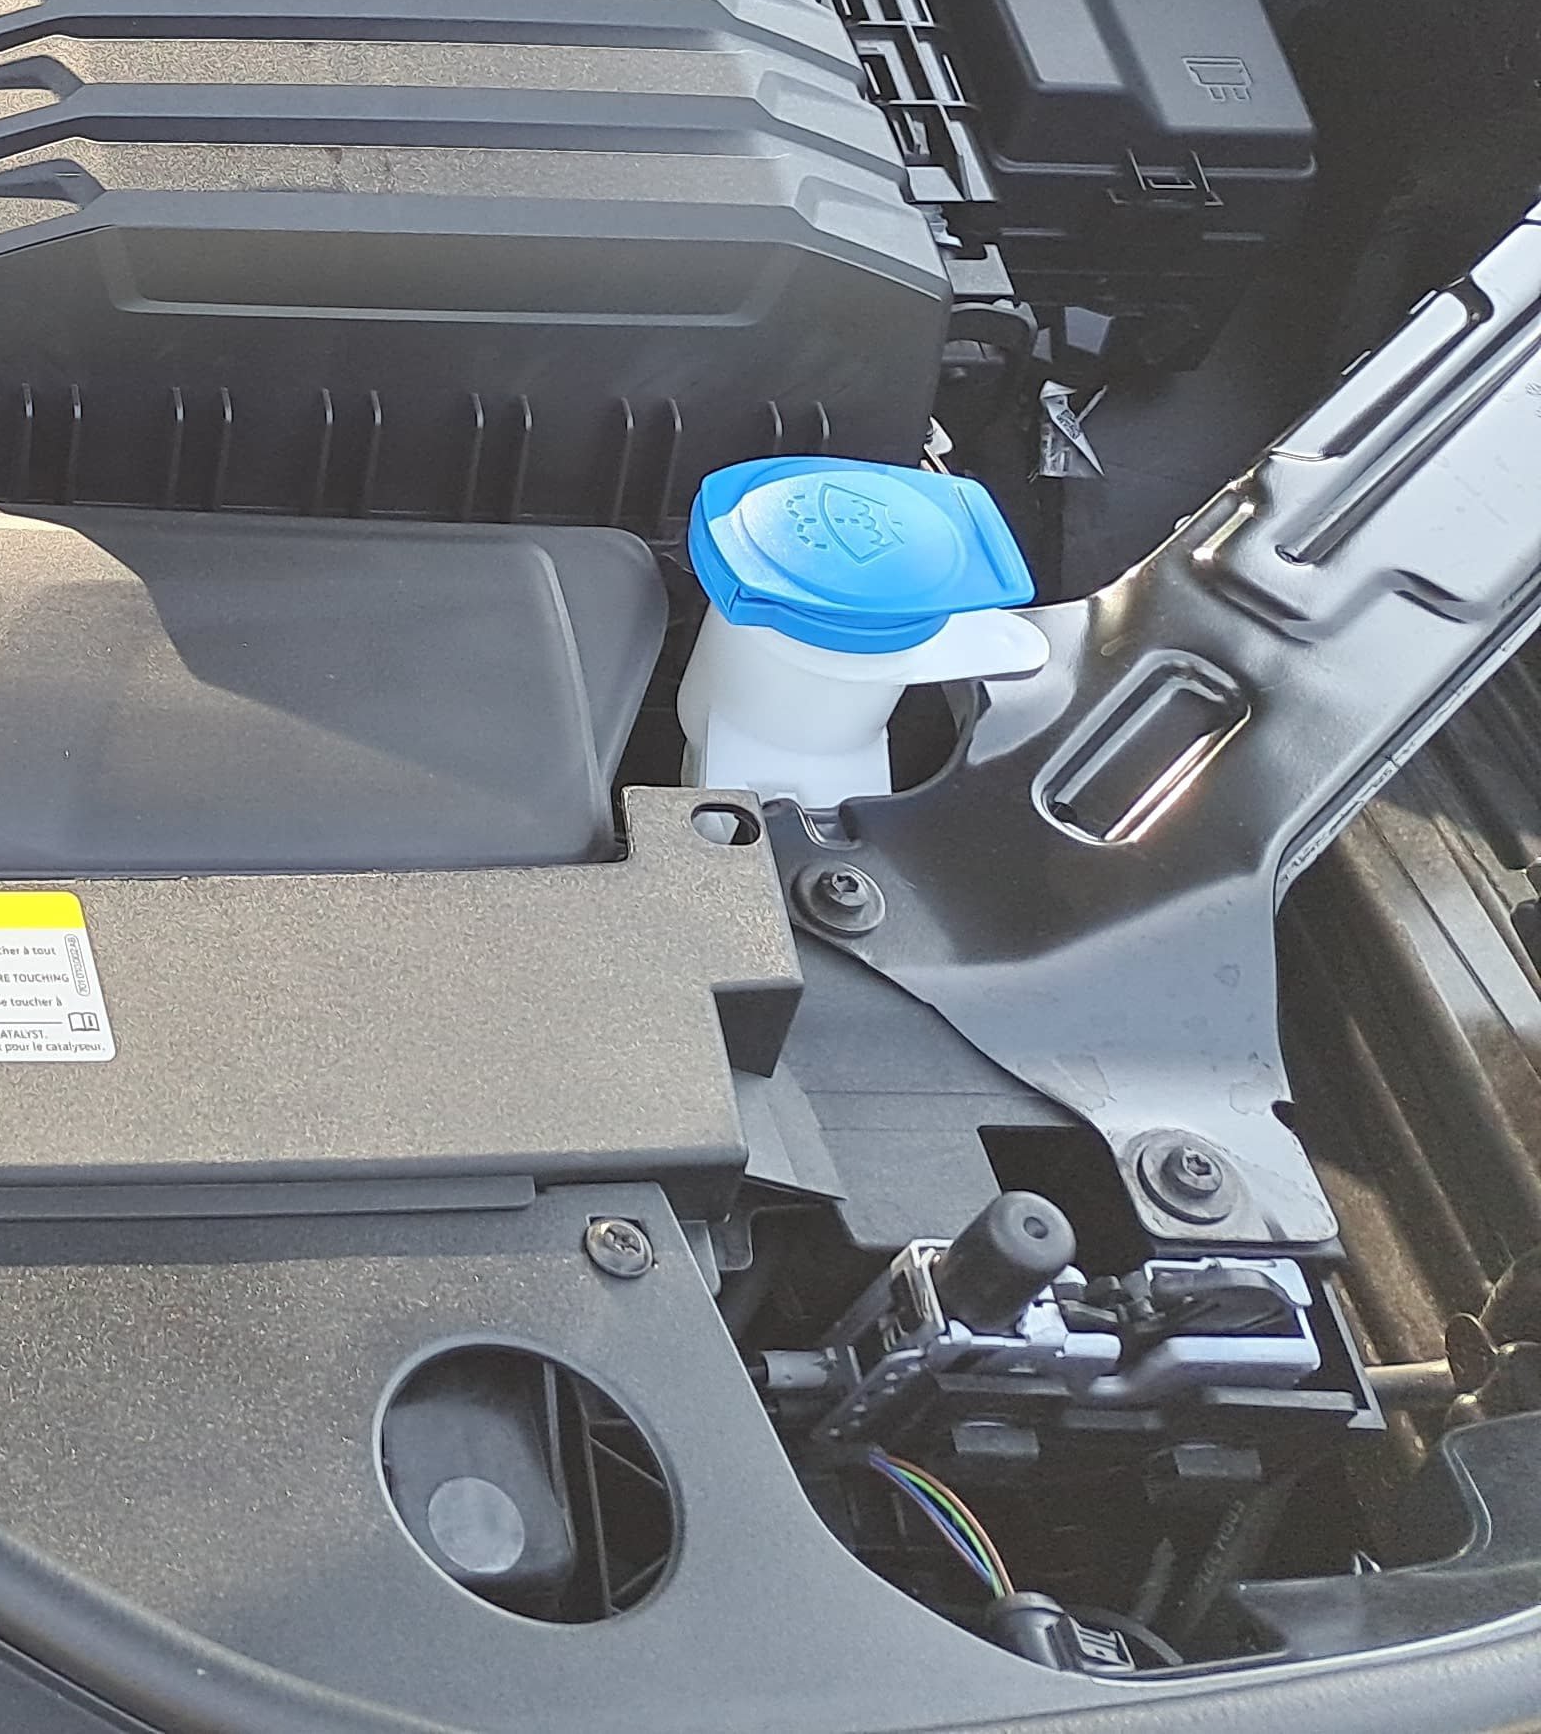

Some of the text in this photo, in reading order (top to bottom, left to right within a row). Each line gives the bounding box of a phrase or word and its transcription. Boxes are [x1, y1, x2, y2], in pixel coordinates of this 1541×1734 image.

[22, 945, 30, 955] à
[31, 946, 57, 956] tout
[12, 972, 70, 983] TOUCHING
[9, 996, 52, 1007] toucher
[55, 995, 63, 1007] à
[4, 1043, 30, 1054] pour
[31, 1040, 43, 1052] le
